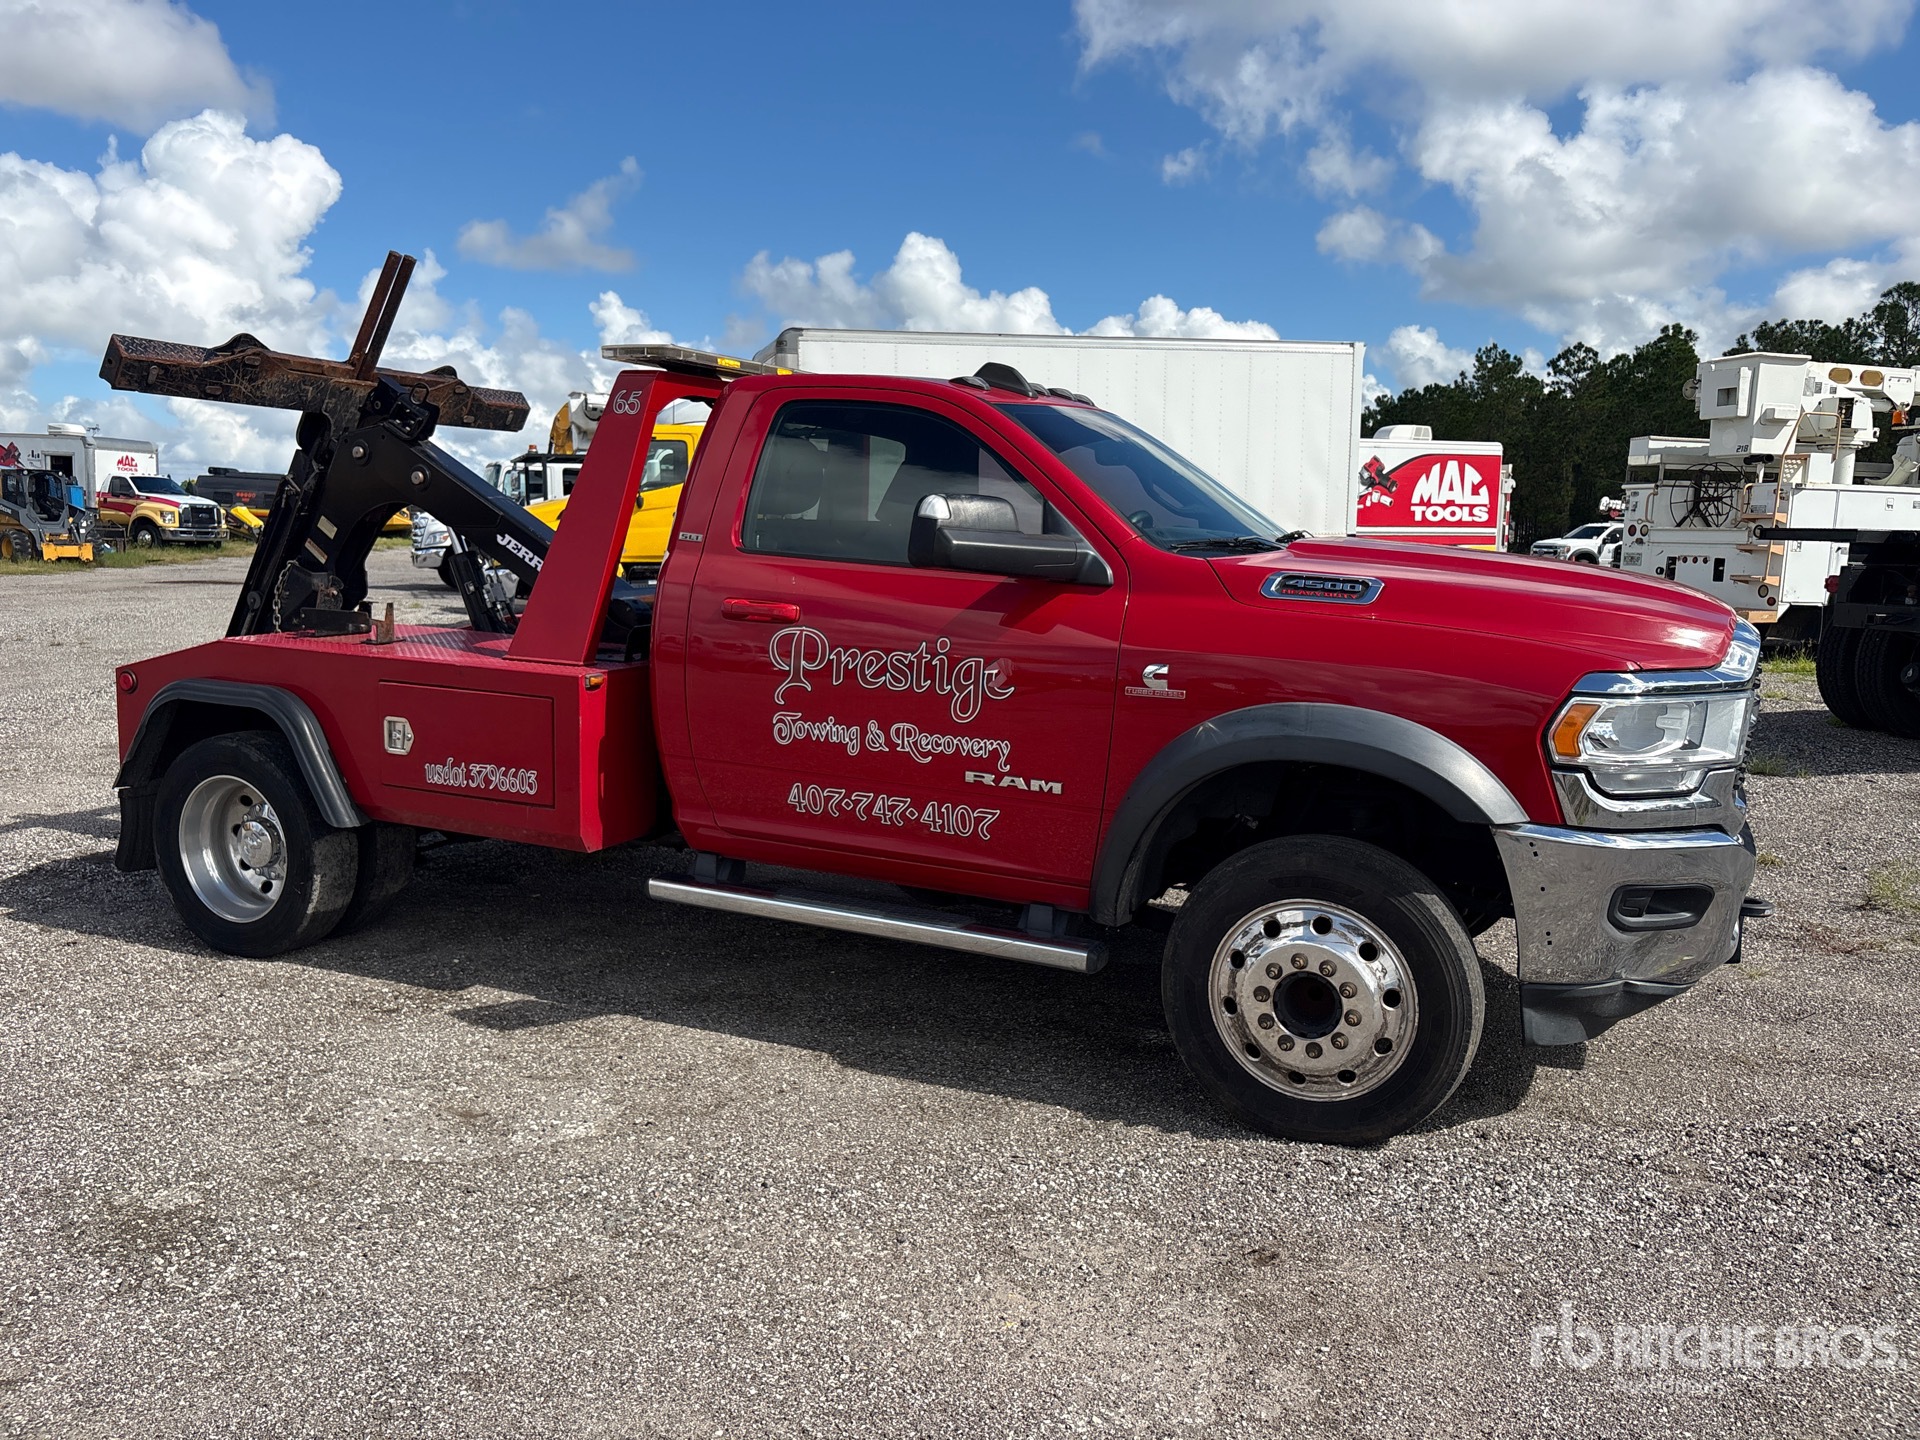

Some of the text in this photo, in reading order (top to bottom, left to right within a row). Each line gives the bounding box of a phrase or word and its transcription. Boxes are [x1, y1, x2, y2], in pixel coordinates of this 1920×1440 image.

[612, 389, 643, 415] 65
[116, 455, 138, 467] MAC
[1410, 460, 1490, 505] MAC
[1410, 505, 1489, 522] TOOLS
[1281, 588, 1321, 597] HEAVY
[1285, 579, 1362, 592] 4500
[1154, 690, 1183, 698] DIESEL
[772, 711, 1011, 772] Towing & Recovery
[425, 757, 538, 795] usdot 3796603
[964, 770, 1064, 795] RAM
